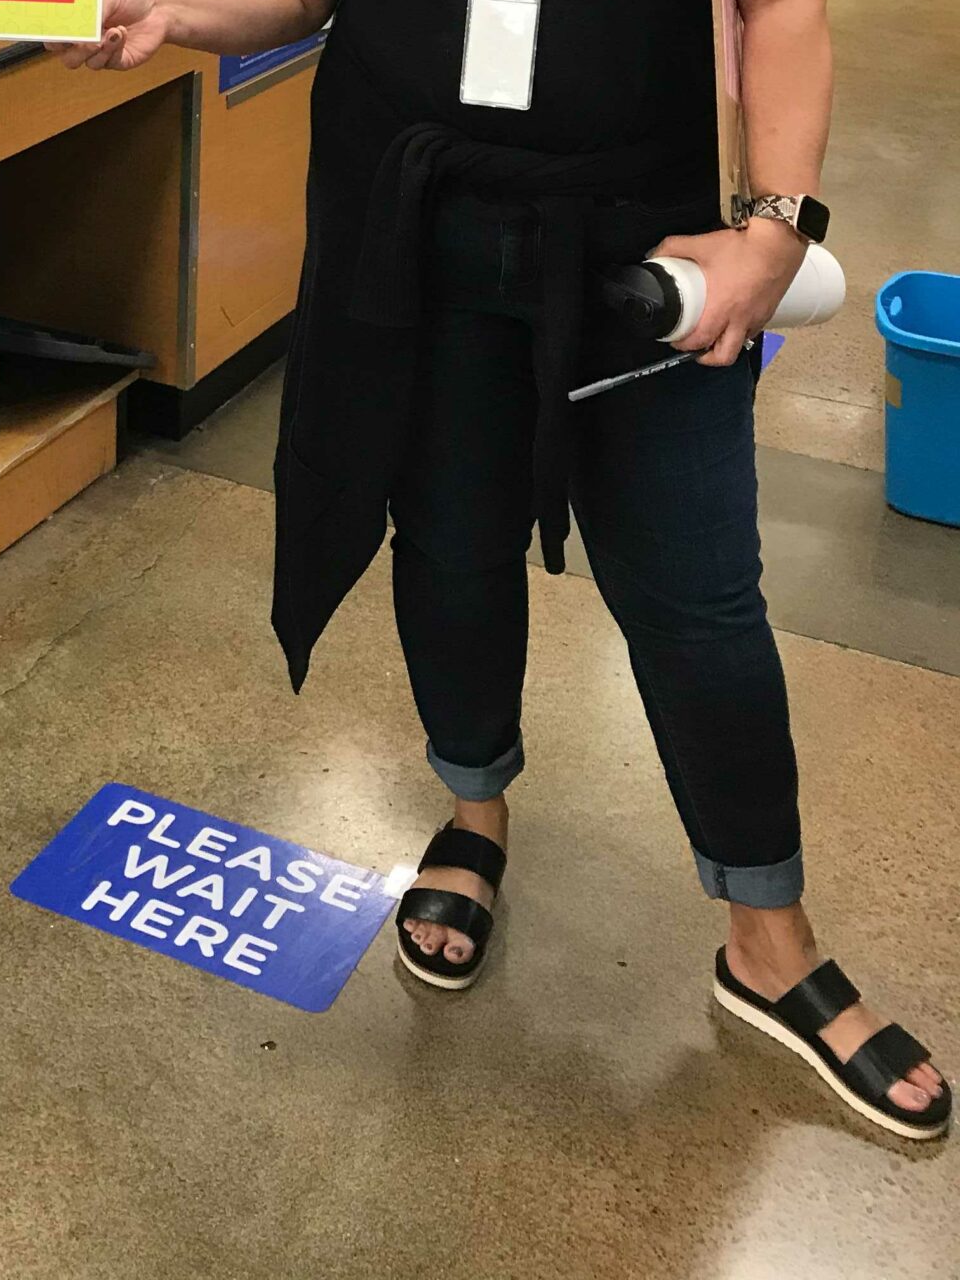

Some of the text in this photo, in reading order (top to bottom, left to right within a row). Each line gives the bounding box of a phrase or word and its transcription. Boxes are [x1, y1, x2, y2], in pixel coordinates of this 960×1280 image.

[106, 798, 372, 912] PLEASE
[123, 844, 305, 930] WAIT
[80, 880, 279, 976] HERE
